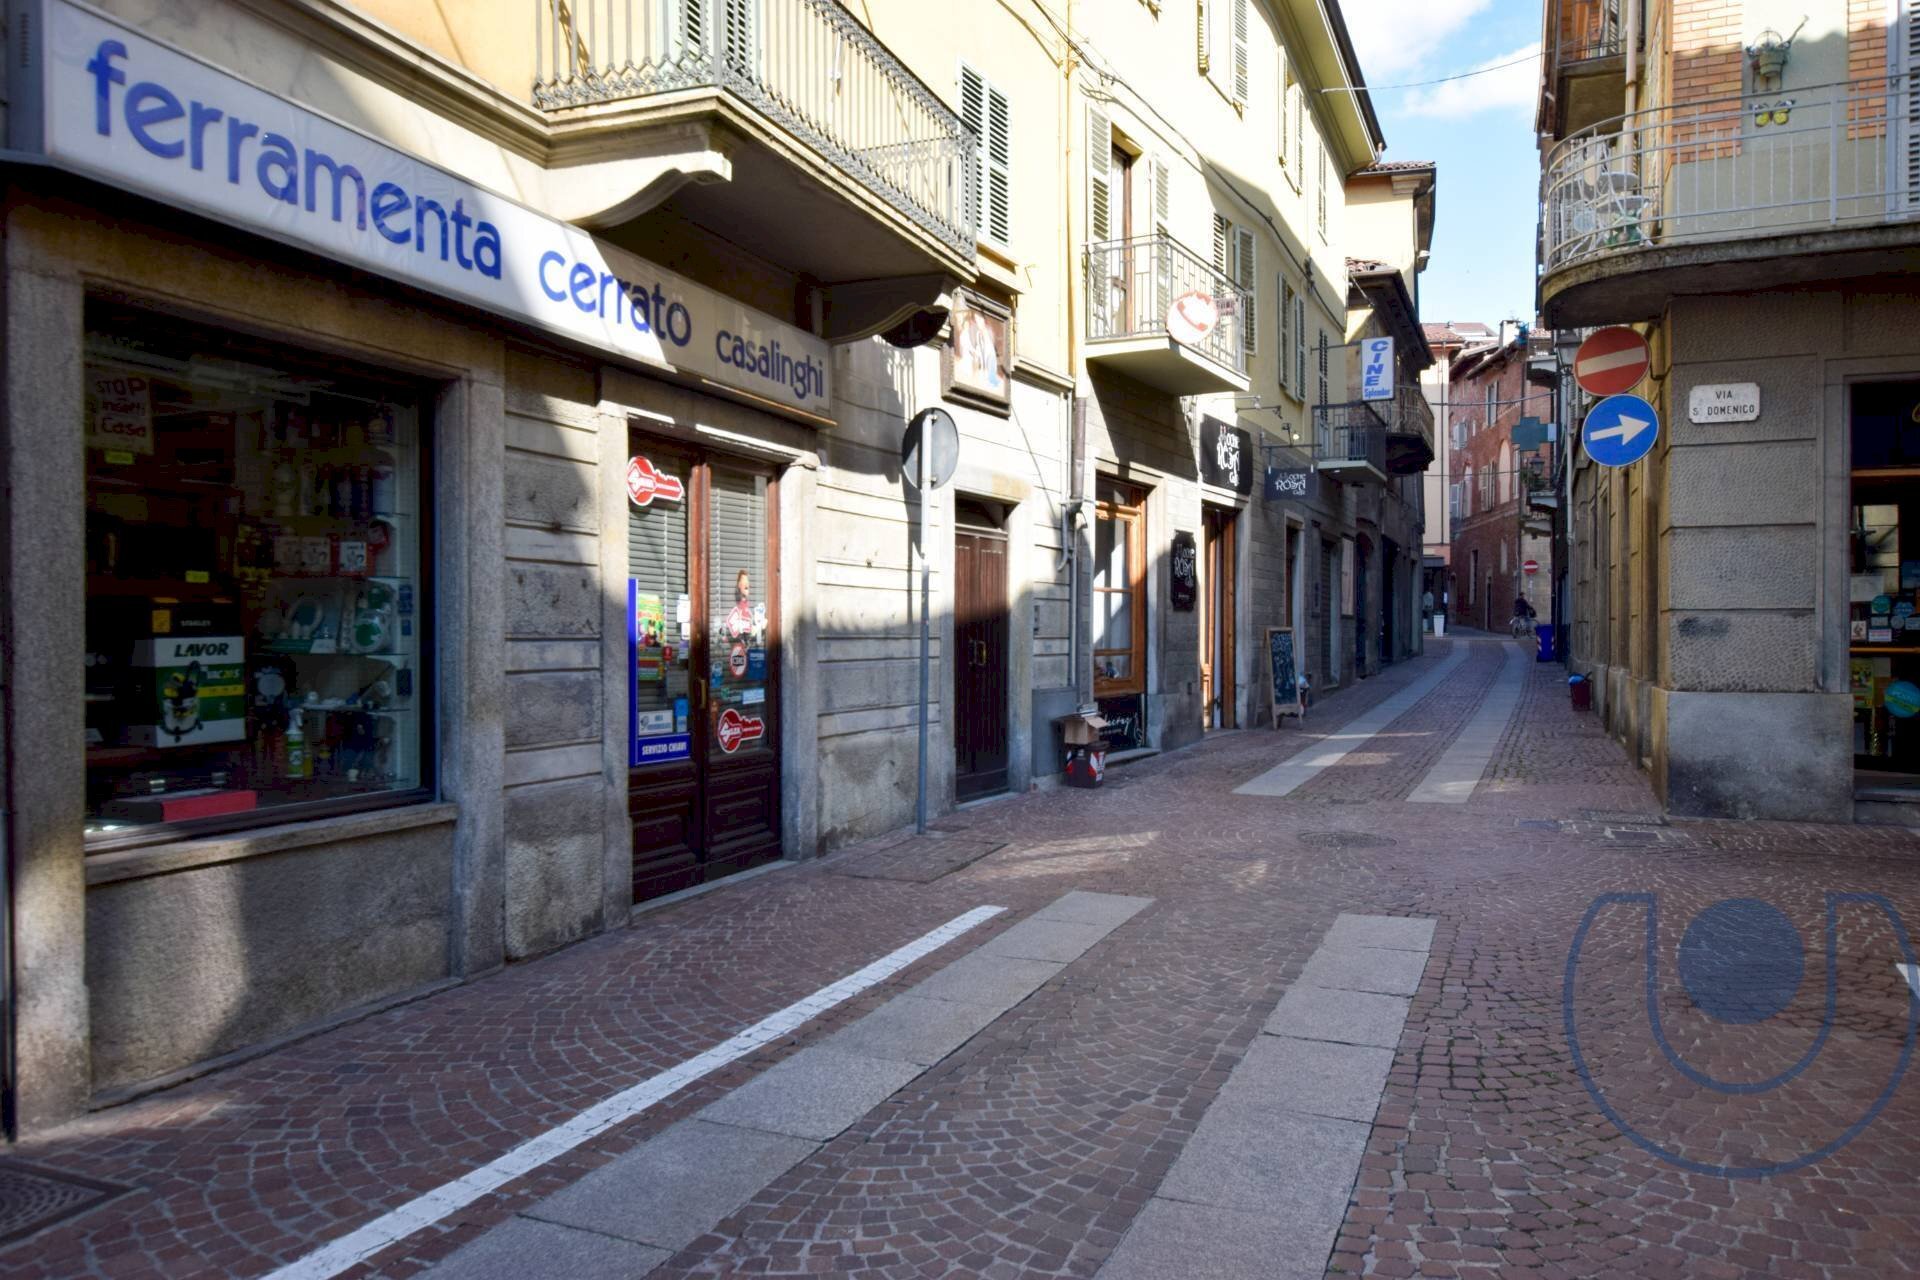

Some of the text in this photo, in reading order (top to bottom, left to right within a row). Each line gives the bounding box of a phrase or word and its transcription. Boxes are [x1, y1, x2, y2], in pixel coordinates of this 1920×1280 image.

[86, 40, 823, 399] ferramenta cerrato casalinghi
[1365, 341, 1389, 386] CINE
[96, 378, 146, 395] STOP
[1715, 390, 1733, 400] VIA
[1707, 404, 1755, 416] DOMENICO
[174, 642, 229, 657] LAVOR
[642, 743, 668, 756] SERVIZIO
